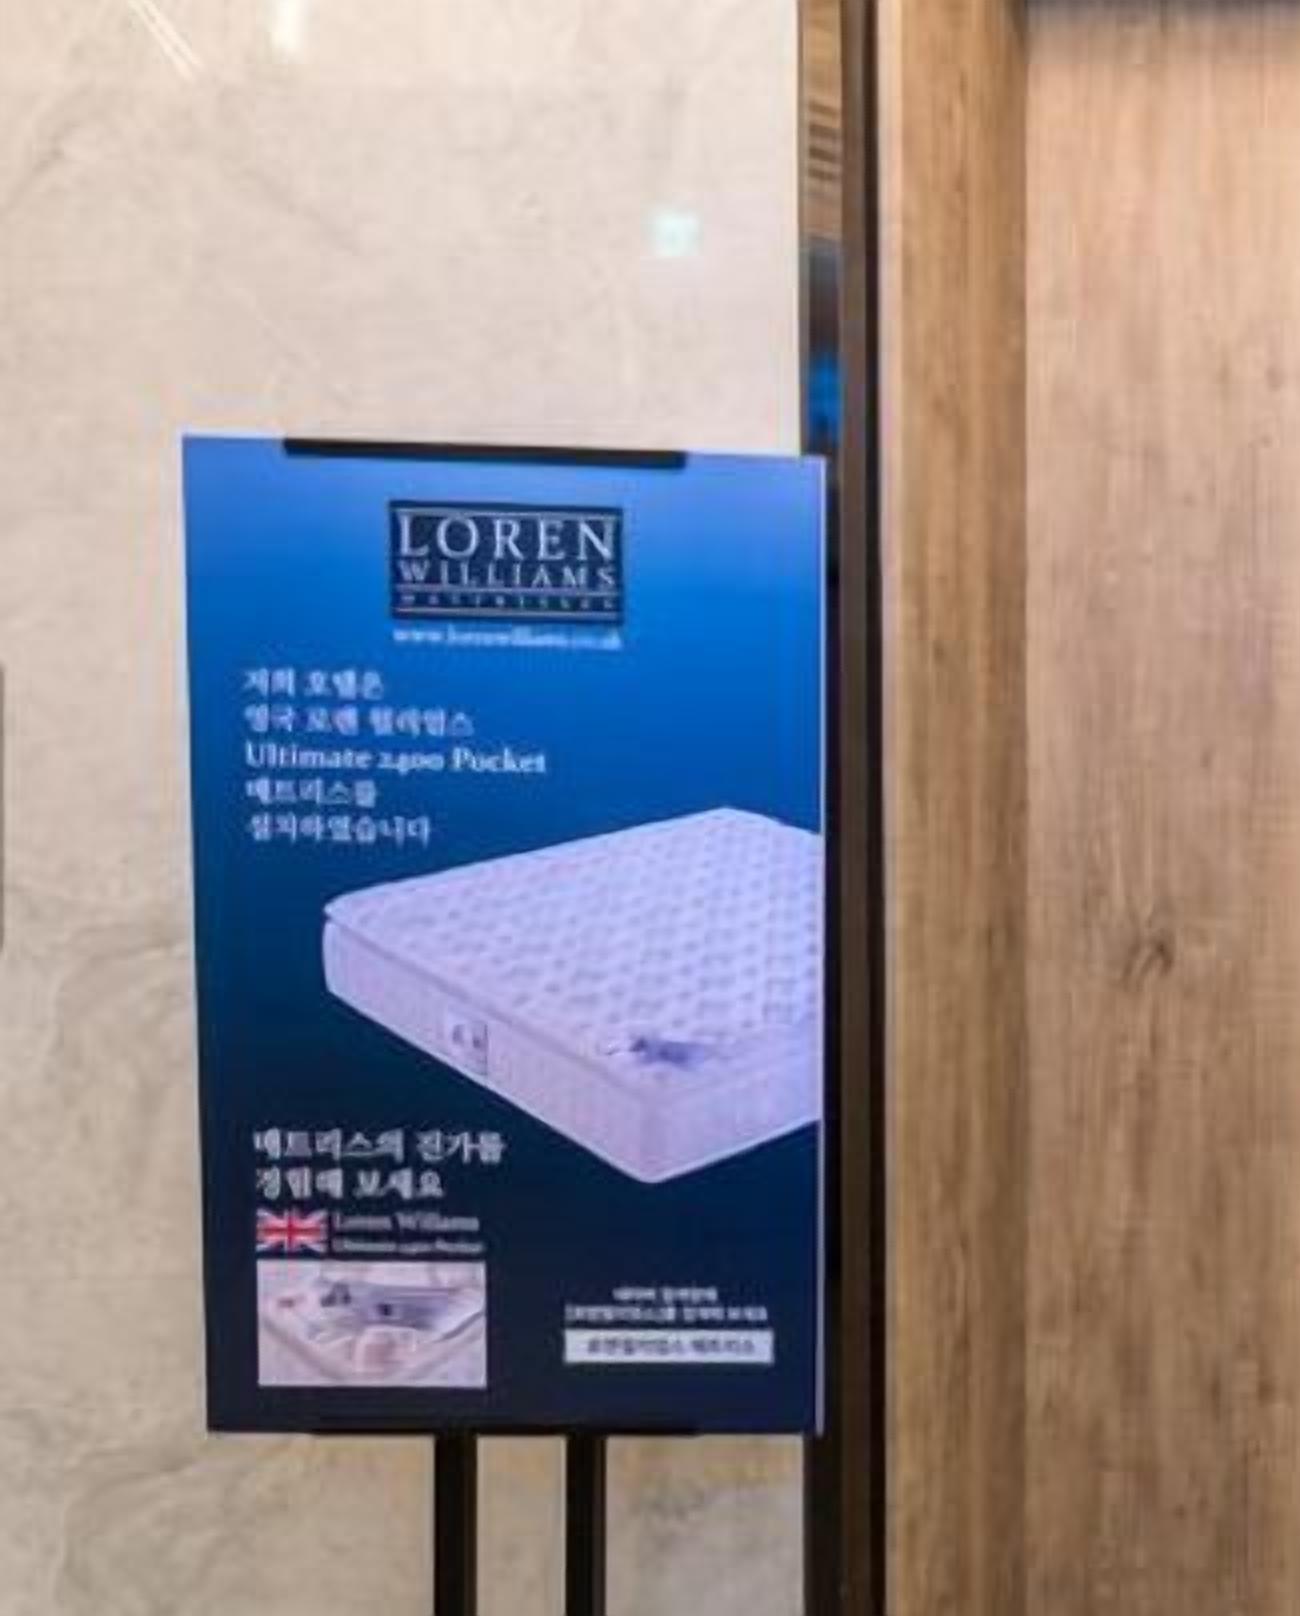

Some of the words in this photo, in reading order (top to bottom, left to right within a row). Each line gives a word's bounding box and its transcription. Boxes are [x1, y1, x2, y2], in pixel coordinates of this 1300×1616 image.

[398, 514, 615, 561] LOREN
[397, 559, 615, 588] WILLIAMS
[244, 667, 295, 698] 저희
[246, 741, 371, 770] Ultimate
[376, 751, 445, 776] 2400
[452, 746, 547, 773] Pocket
[246, 777, 376, 808] 매트리스를
[250, 815, 430, 848] 설치하였습니다
[253, 1128, 404, 1163] 매트리스의
[415, 1131, 504, 1165] 진가를
[256, 1166, 343, 1200] 경험해
[353, 1167, 445, 1200] 보세요
